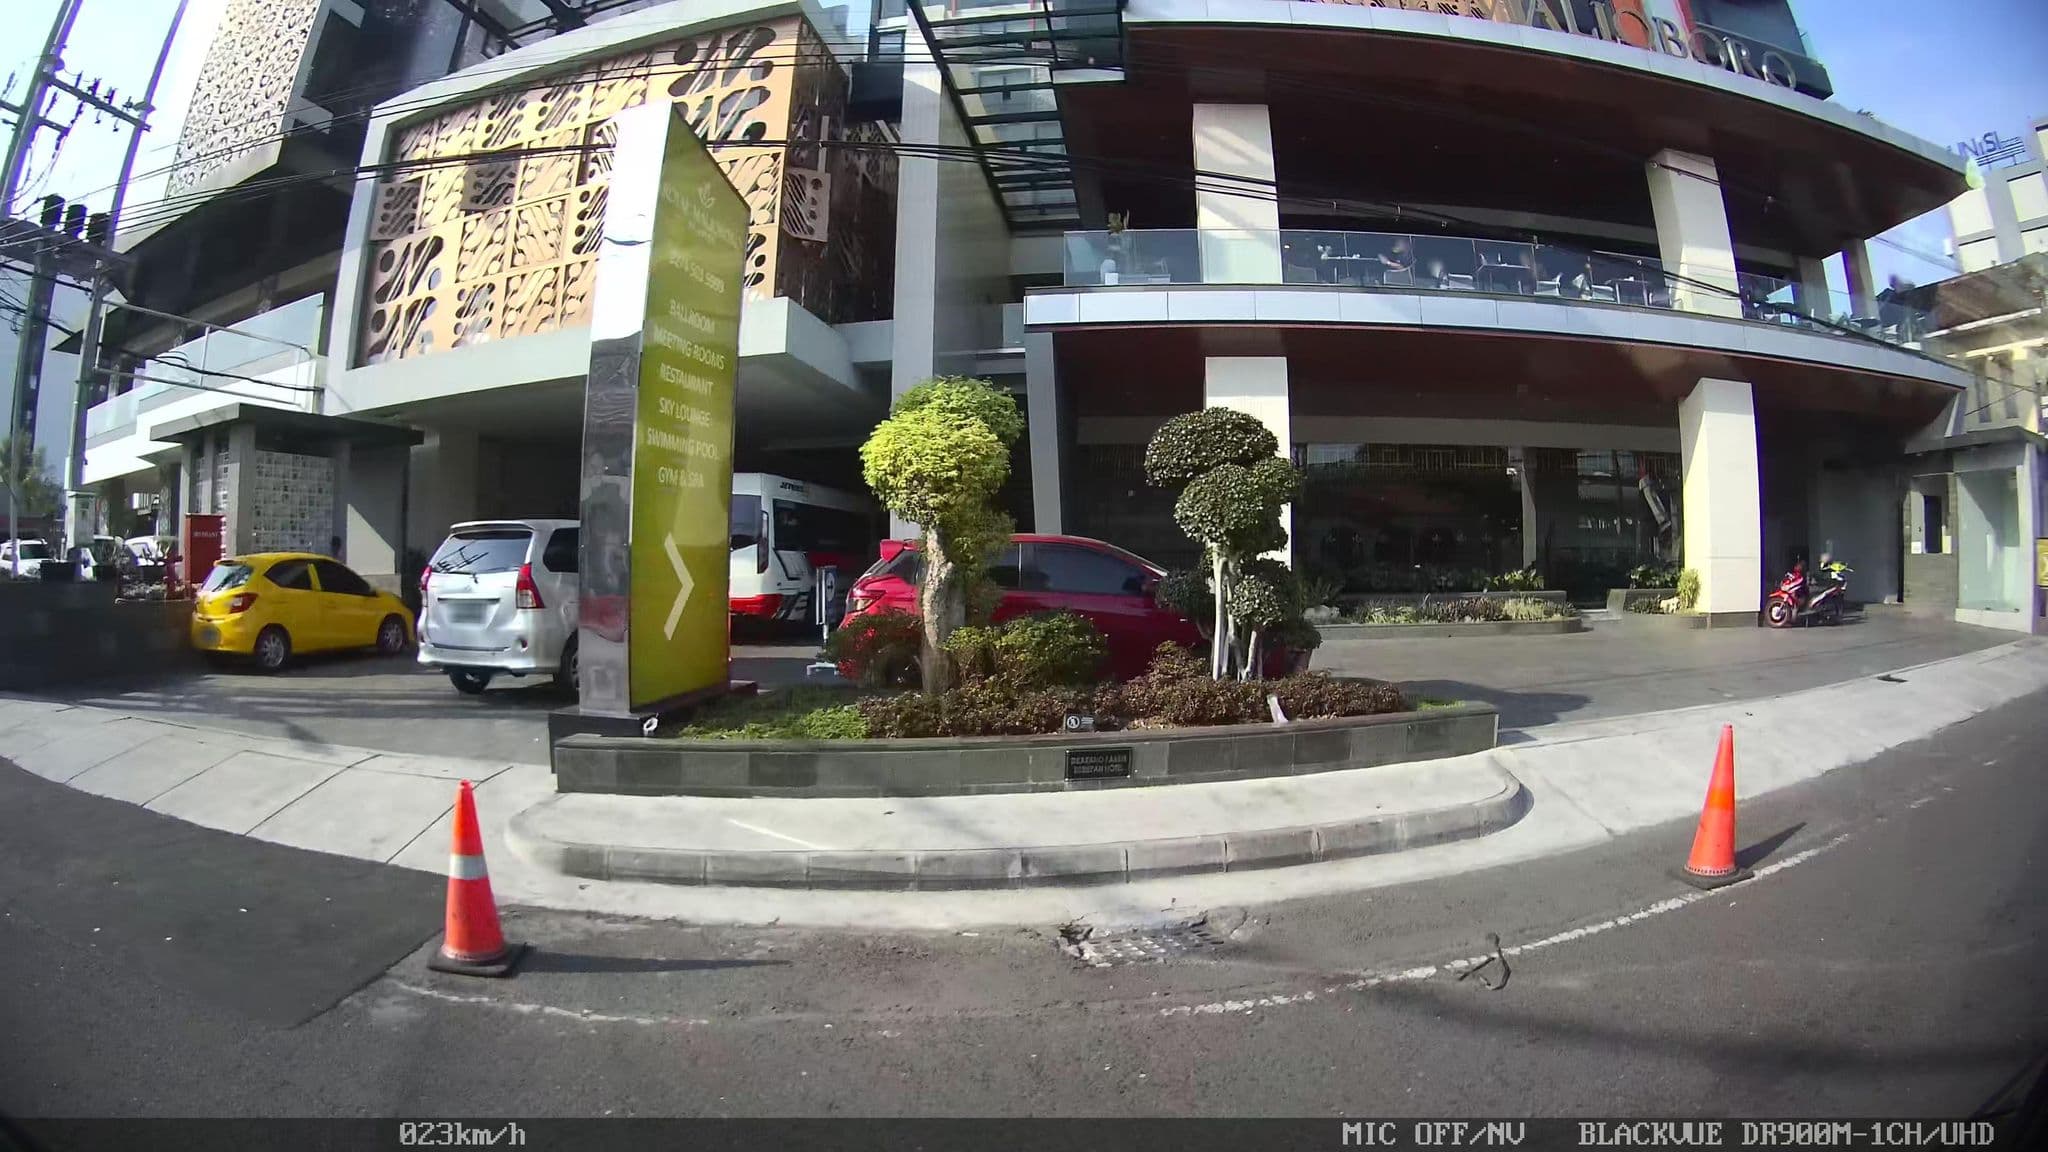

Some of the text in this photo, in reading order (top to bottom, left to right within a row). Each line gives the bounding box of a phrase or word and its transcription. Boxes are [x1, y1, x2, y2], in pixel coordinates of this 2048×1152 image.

[669, 298, 716, 335] BALLROOM
[654, 323, 726, 370] MEETING ROOMS
[660, 362, 714, 396] RESTAURANT
[659, 397, 712, 428] SKY LOUNGE
[647, 427, 720, 460] SWIMMING POOL
[658, 466, 679, 488] GYM
